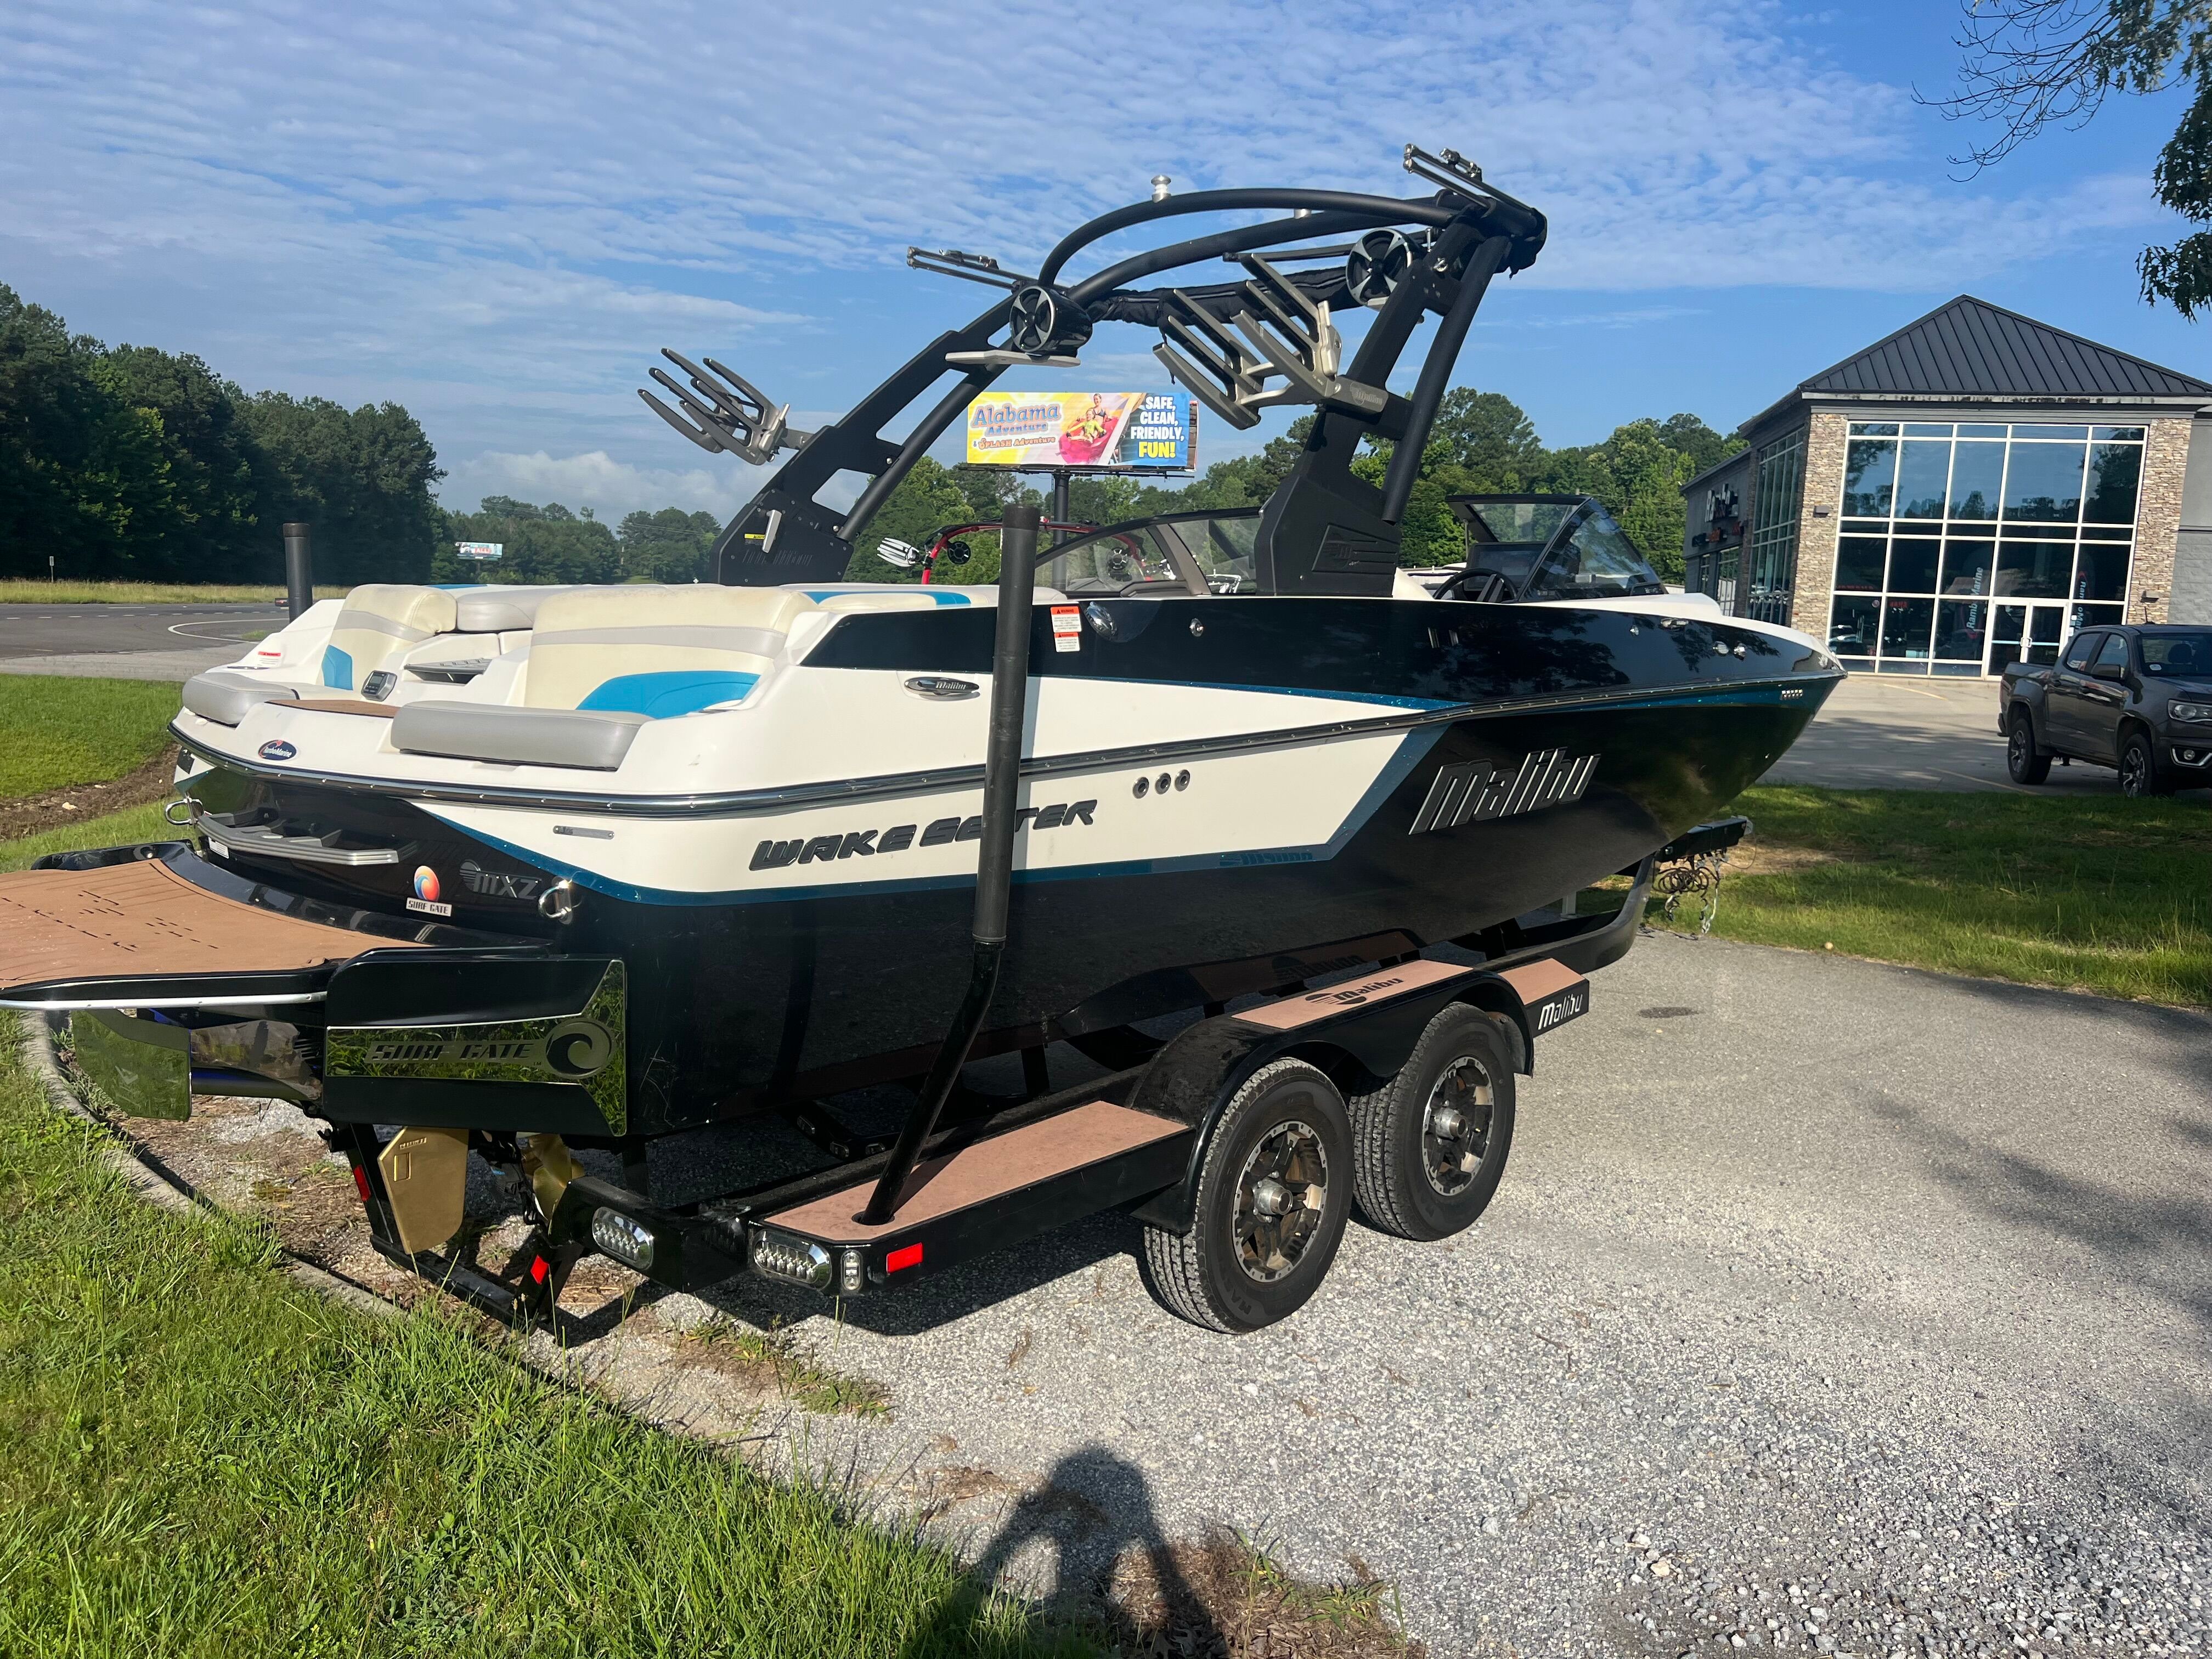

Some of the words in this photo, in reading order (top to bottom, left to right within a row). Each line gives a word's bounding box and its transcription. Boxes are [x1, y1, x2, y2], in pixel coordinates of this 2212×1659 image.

[1145, 396, 1176, 411] SAFE,
[974, 405, 1059, 426] Alabama
[1139, 411, 1178, 426] CLEAN,
[988, 424, 1046, 436] Adventure
[1130, 426, 1184, 441] FRIENDLY,
[1013, 437, 1056, 446] Adventure
[1138, 441, 1176, 458] FUN!
[1408, 746, 1601, 835] Malibu
[919, 799, 1098, 847] SETER
[408, 900, 427, 910] SURF
[430, 904, 449, 915] GATE
[1331, 978, 1404, 1001] Malibu
[1538, 994, 1583, 1030] Malibu
[373, 1045, 454, 1060] SURF
[459, 1043, 534, 1059] GATE
